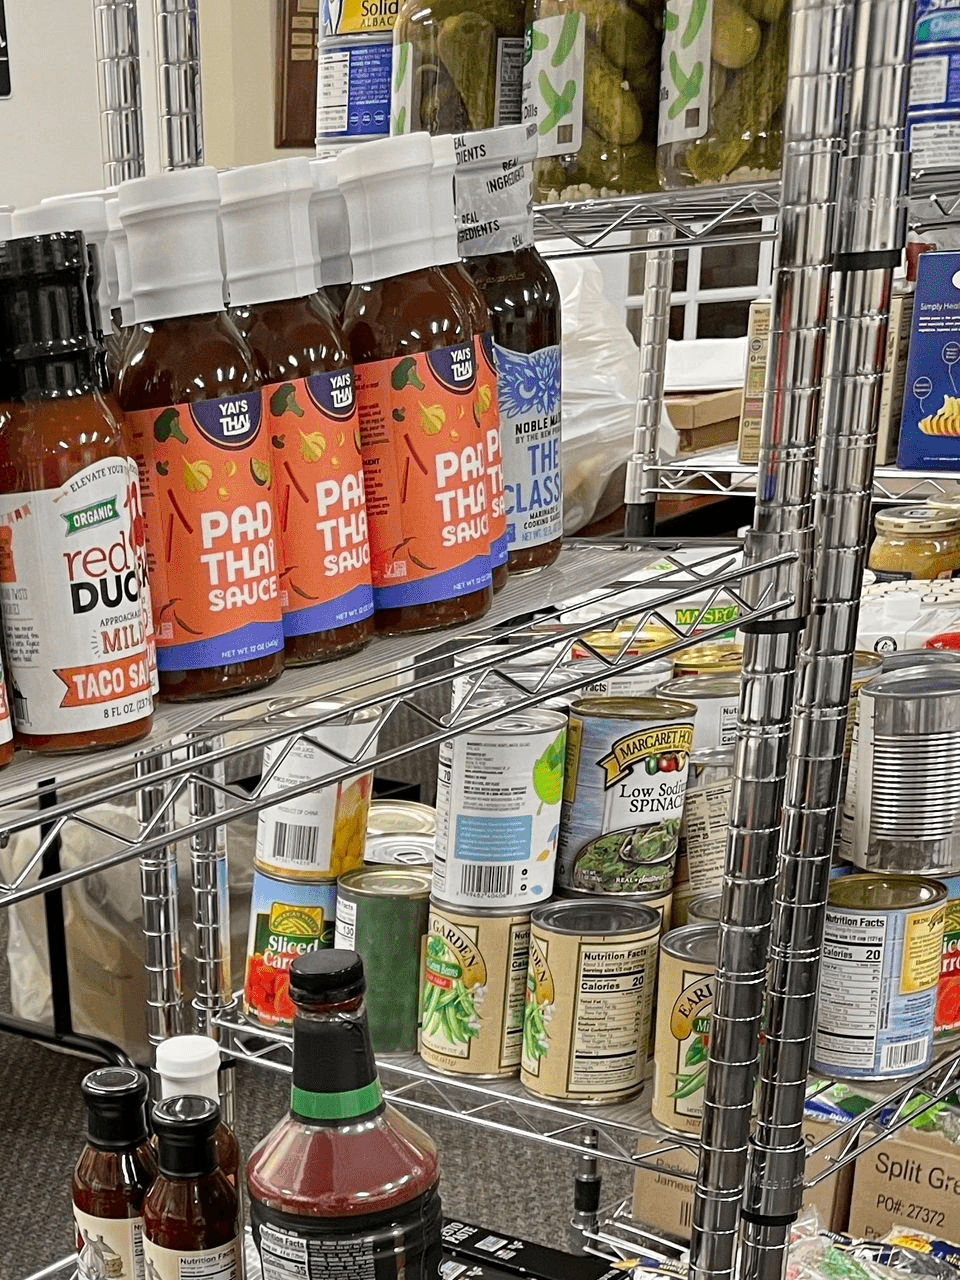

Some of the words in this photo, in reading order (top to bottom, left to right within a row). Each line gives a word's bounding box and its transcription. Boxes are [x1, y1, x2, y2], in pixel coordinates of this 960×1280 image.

[361, 0, 399, 17] Solid
[361, 16, 394, 27] ALBAC
[219, 399, 248, 416] YAI'S
[515, 417, 549, 435] NOBLE
[527, 438, 559, 476] THE
[70, 470, 106, 493] ELEVATE
[73, 506, 115, 528] ORGANIC
[201, 501, 272, 549] PAD
[63, 530, 131, 582] red
[201, 538, 275, 587] THAI
[208, 579, 278, 612] SAUCE
[72, 668, 125, 700] TACO
[111, 706, 122, 717] FL
[619, 730, 677, 760] MARGARET
[619, 783, 655, 799] Low
[629, 794, 686, 813] SPINAC
[825, 912, 858, 927] Nutrition
[860, 917, 885, 928] Facts
[342, 926, 355, 937] 130
[267, 937, 319, 955] Sliced
[432, 918, 479, 969] GARDEN
[584, 951, 626, 961] Nutrition
[627, 948, 647, 960] Facts
[823, 946, 853, 960] Calories
[865, 949, 881, 961] 20
[581, 982, 621, 991] Calories
[632, 976, 644, 988] 20
[875, 1152, 921, 1184] Split
[876, 1193, 906, 1217] PO#:
[906, 1202, 946, 1229] 27372
[284, 1236, 306, 1249] Facts
[180, 1254, 217, 1265] Nutrition
